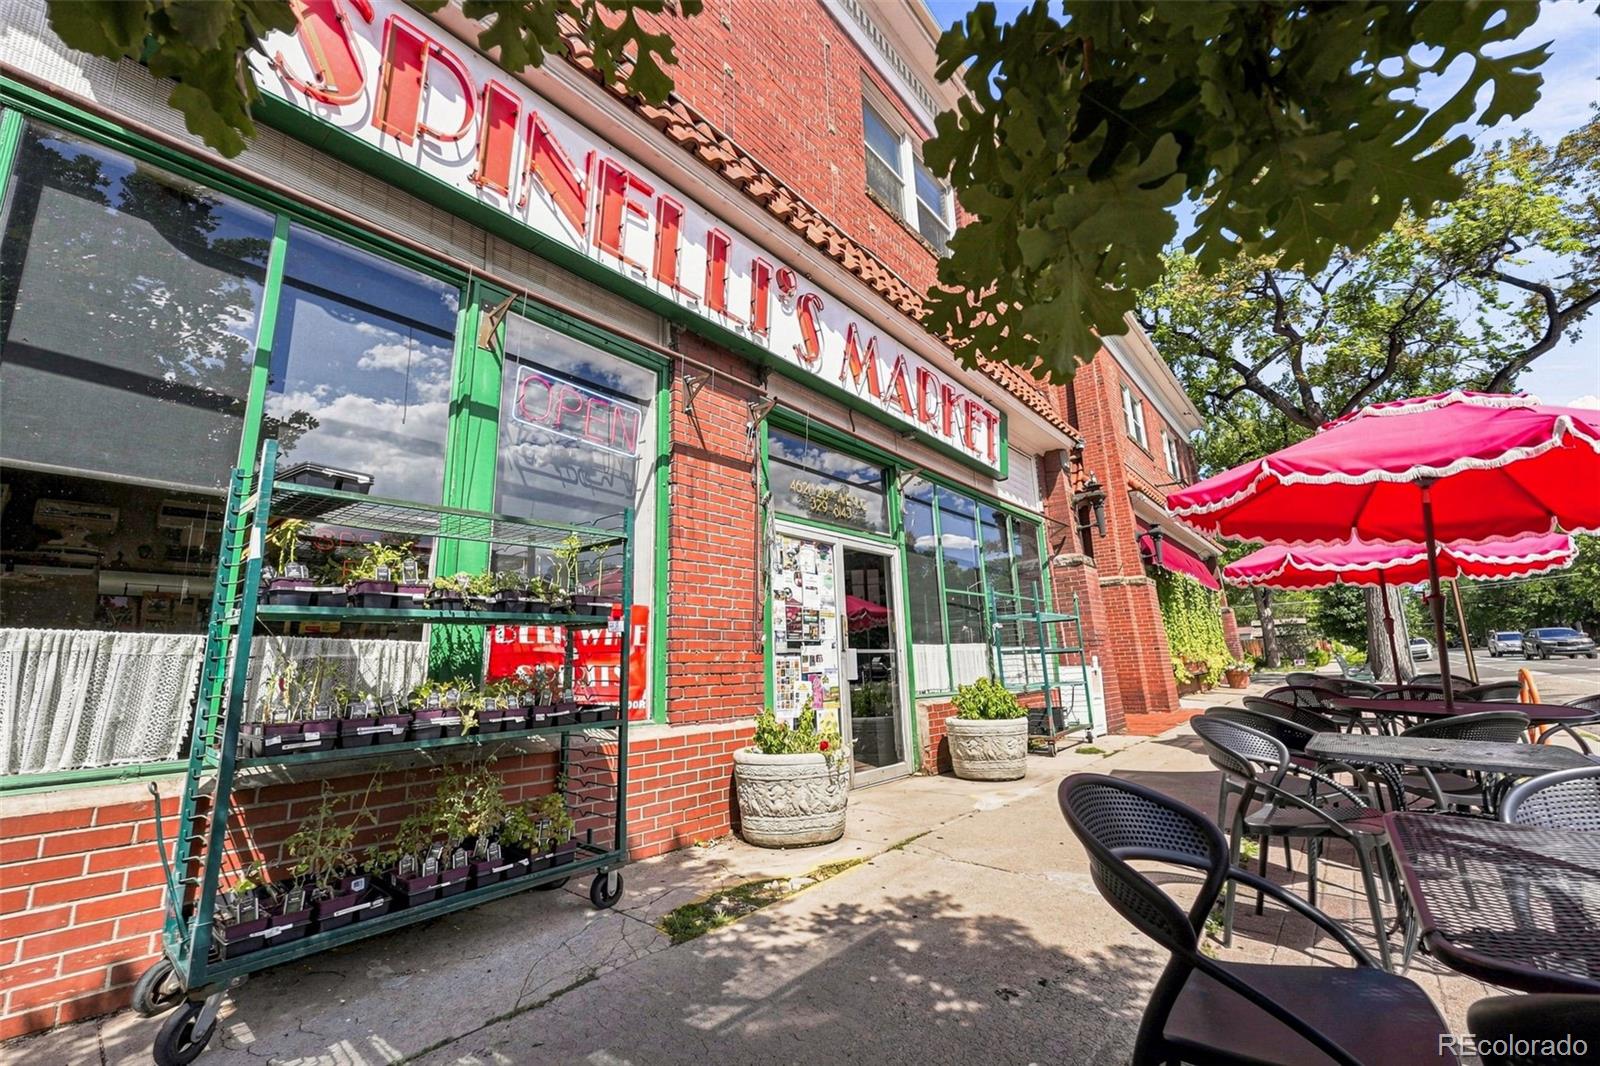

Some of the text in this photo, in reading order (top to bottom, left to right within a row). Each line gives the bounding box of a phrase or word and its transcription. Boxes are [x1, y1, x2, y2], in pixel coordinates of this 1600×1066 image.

[273, 0, 1000, 464] SPINELLI'S MARKET
[519, 374, 638, 453] OPEN
